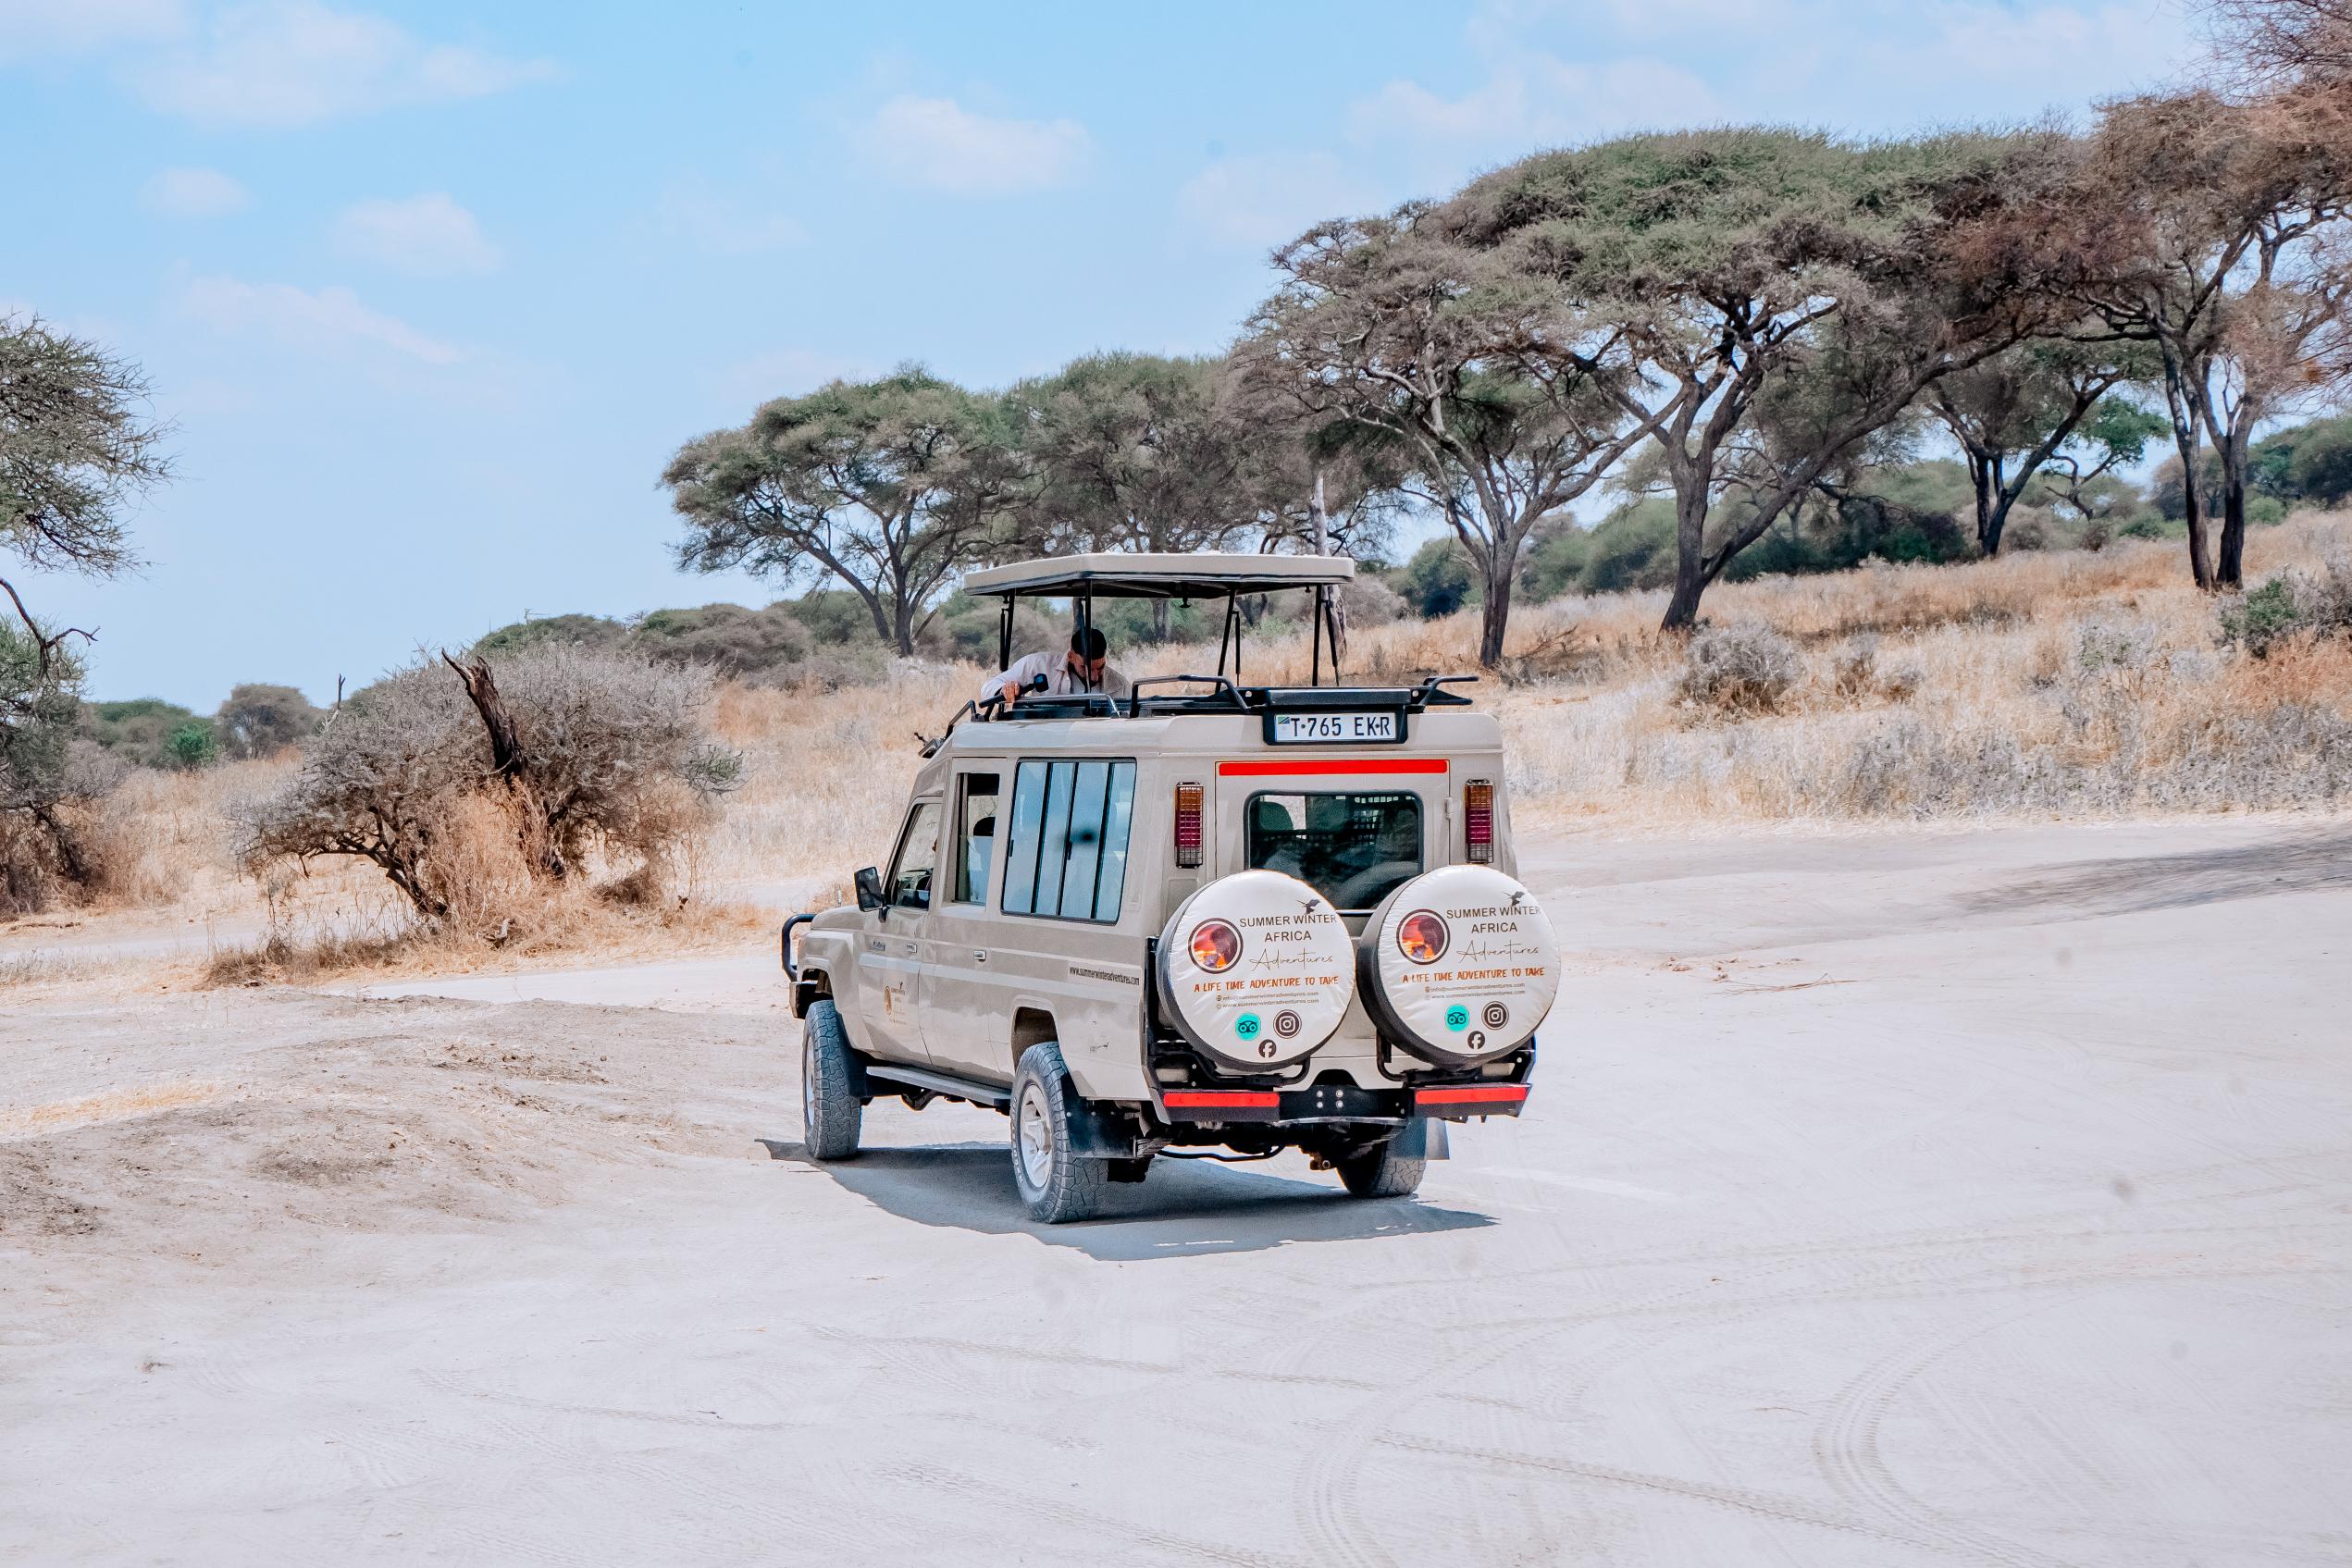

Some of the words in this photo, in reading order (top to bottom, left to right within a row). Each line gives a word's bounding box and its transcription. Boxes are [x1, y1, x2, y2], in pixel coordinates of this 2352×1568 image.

[1307, 717, 1342, 736] 765
[1355, 716, 1391, 736] EKR
[1239, 913, 1291, 928] SUMMER
[1294, 913, 1337, 925] WINTER
[1446, 906, 1496, 920] SUMMER
[1500, 905, 1541, 917] WINTER
[1471, 921, 1518, 934] AFRICA
[1264, 930, 1312, 943] AFRICA
[1249, 946, 1333, 971] Adventures
[1456, 939, 1540, 964] Adventures
[1402, 973, 1409, 983] A
[1411, 971, 1430, 983] LIFE
[1433, 971, 1453, 982] TIME
[1456, 968, 1508, 981] ADVENTURE
[1511, 968, 1521, 978] TO
[1524, 967, 1545, 977] TAKE
[1194, 982, 1200, 993] A
[1203, 981, 1222, 993] LIFE
[1225, 980, 1244, 991] TIME
[1249, 977, 1301, 989] ADVENTURE
[1304, 976, 1316, 986] TO
[1318, 975, 1340, 985] TAKE
